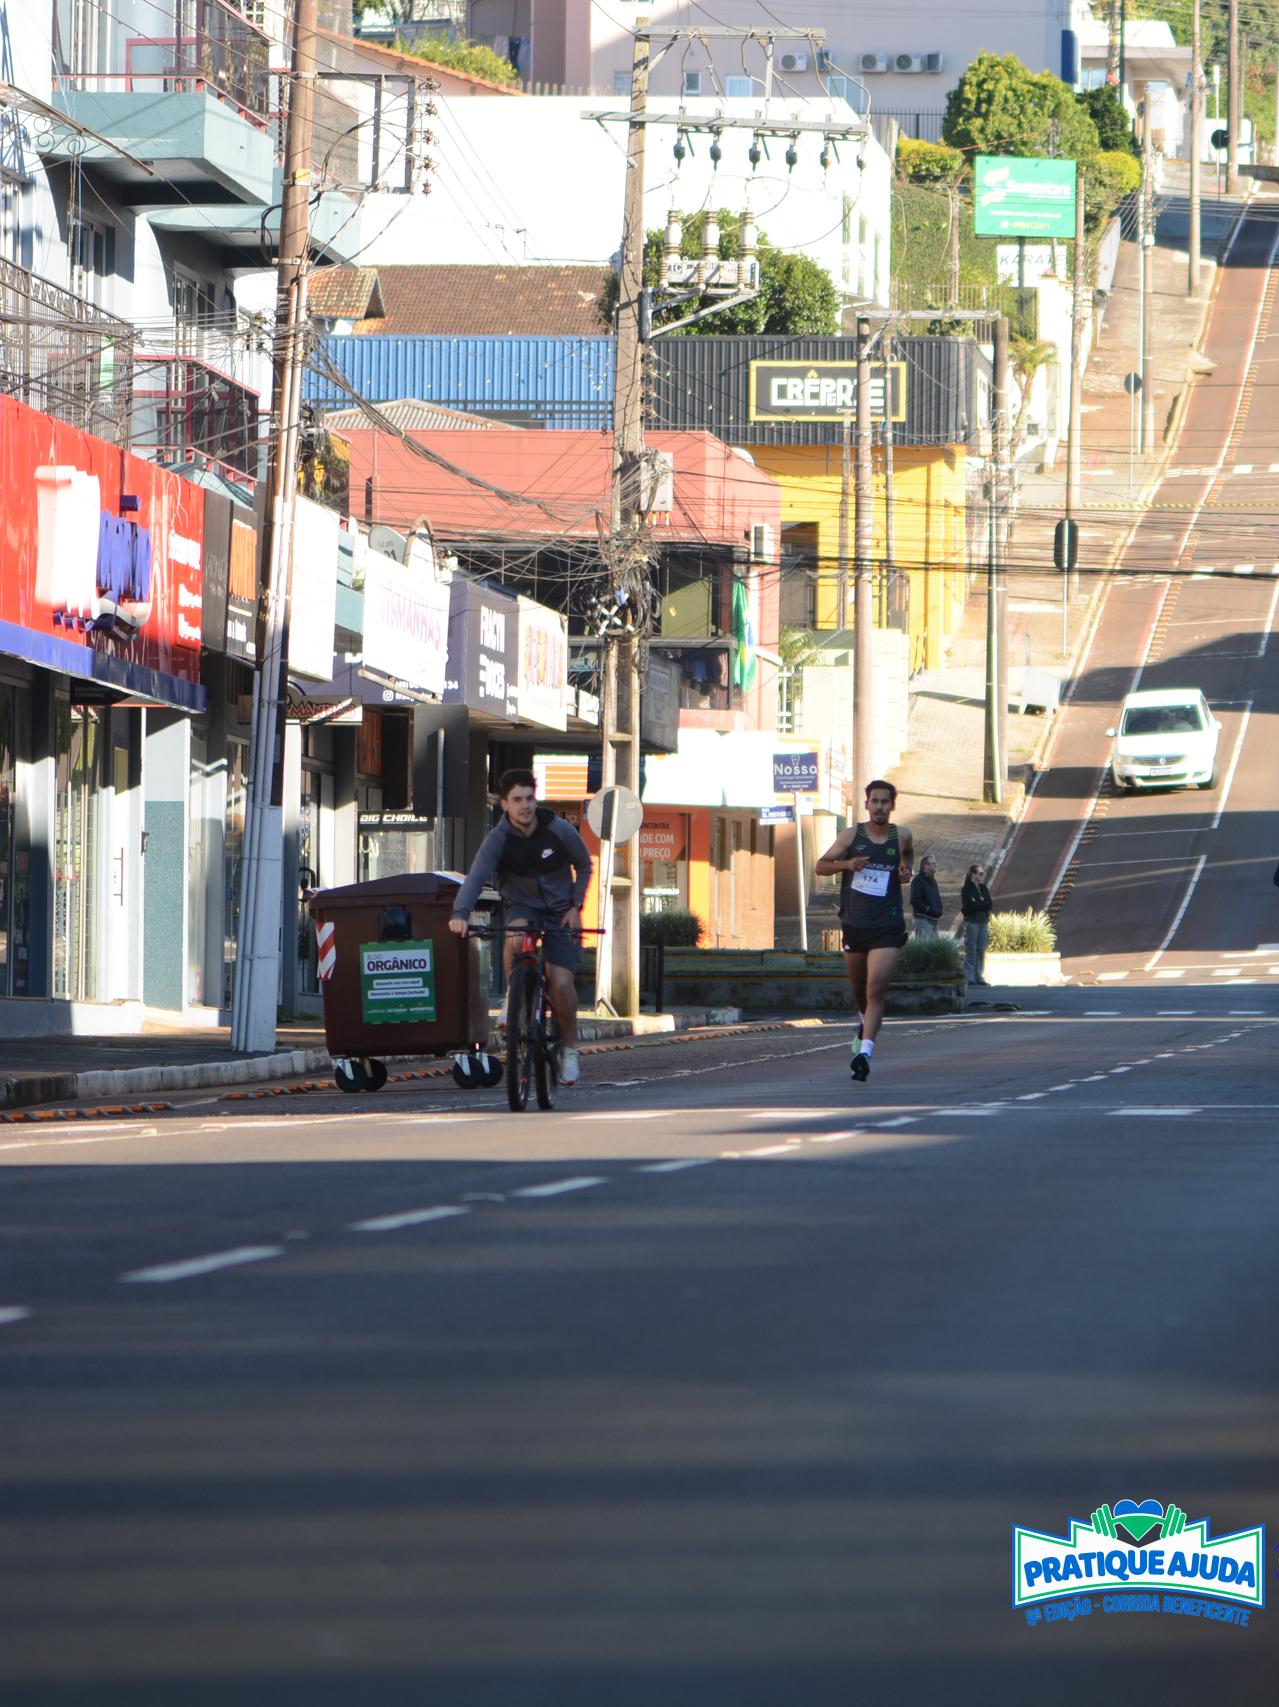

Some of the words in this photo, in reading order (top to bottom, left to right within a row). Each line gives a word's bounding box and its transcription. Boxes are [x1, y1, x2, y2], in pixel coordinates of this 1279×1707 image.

[1005, 179, 1071, 195] Sustentare
[286, 703, 356, 720] MANHAS
[774, 763, 818, 775] Nossa
[360, 814, 380, 822] BIG
[655, 833, 674, 844] COM
[643, 847, 671, 861] PREÇO
[865, 862, 895, 871] ANIUM
[863, 875, 878, 883] 174
[367, 957, 427, 971] ORGÂNICO
